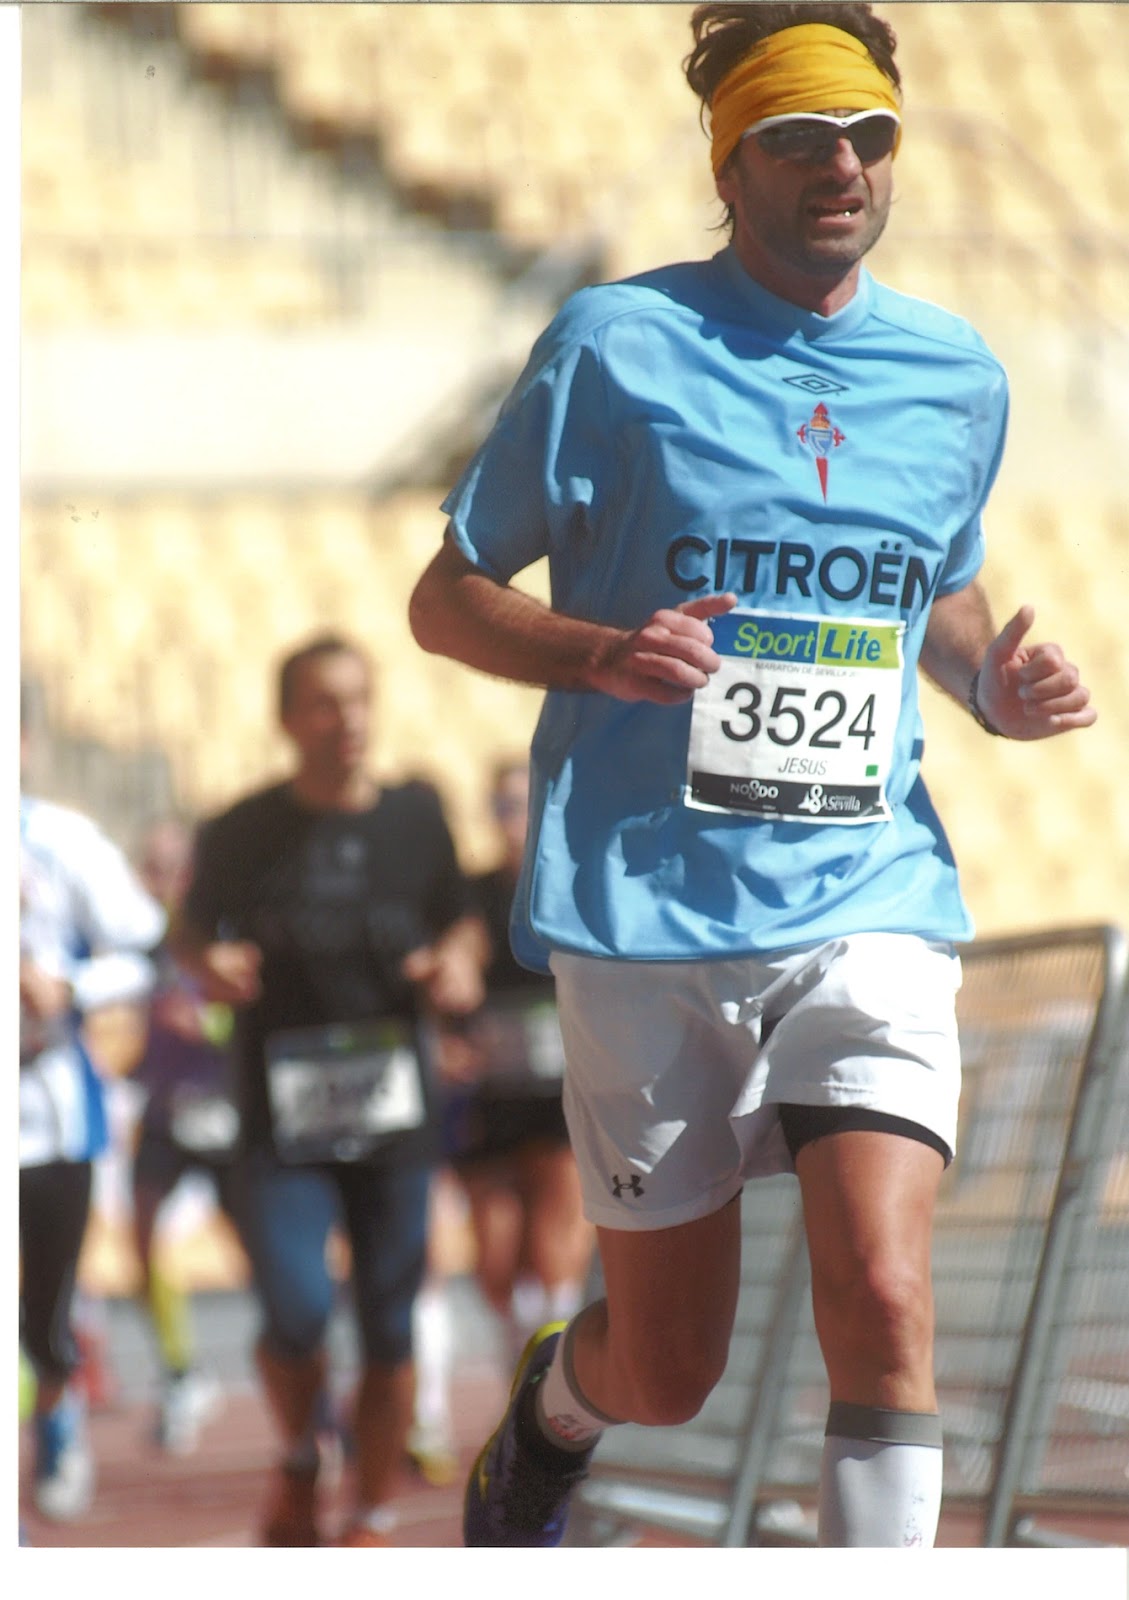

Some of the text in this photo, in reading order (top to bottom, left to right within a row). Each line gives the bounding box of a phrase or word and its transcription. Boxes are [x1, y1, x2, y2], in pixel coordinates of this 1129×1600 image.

[665, 534, 942, 612] CITROËN
[734, 622, 881, 663] Sport Life
[801, 665, 813, 675] DE
[815, 667, 847, 678] SEVILLA
[721, 682, 876, 751] 3524
[778, 757, 828, 776] JESUS
[828, 795, 861, 812] Sevilla
